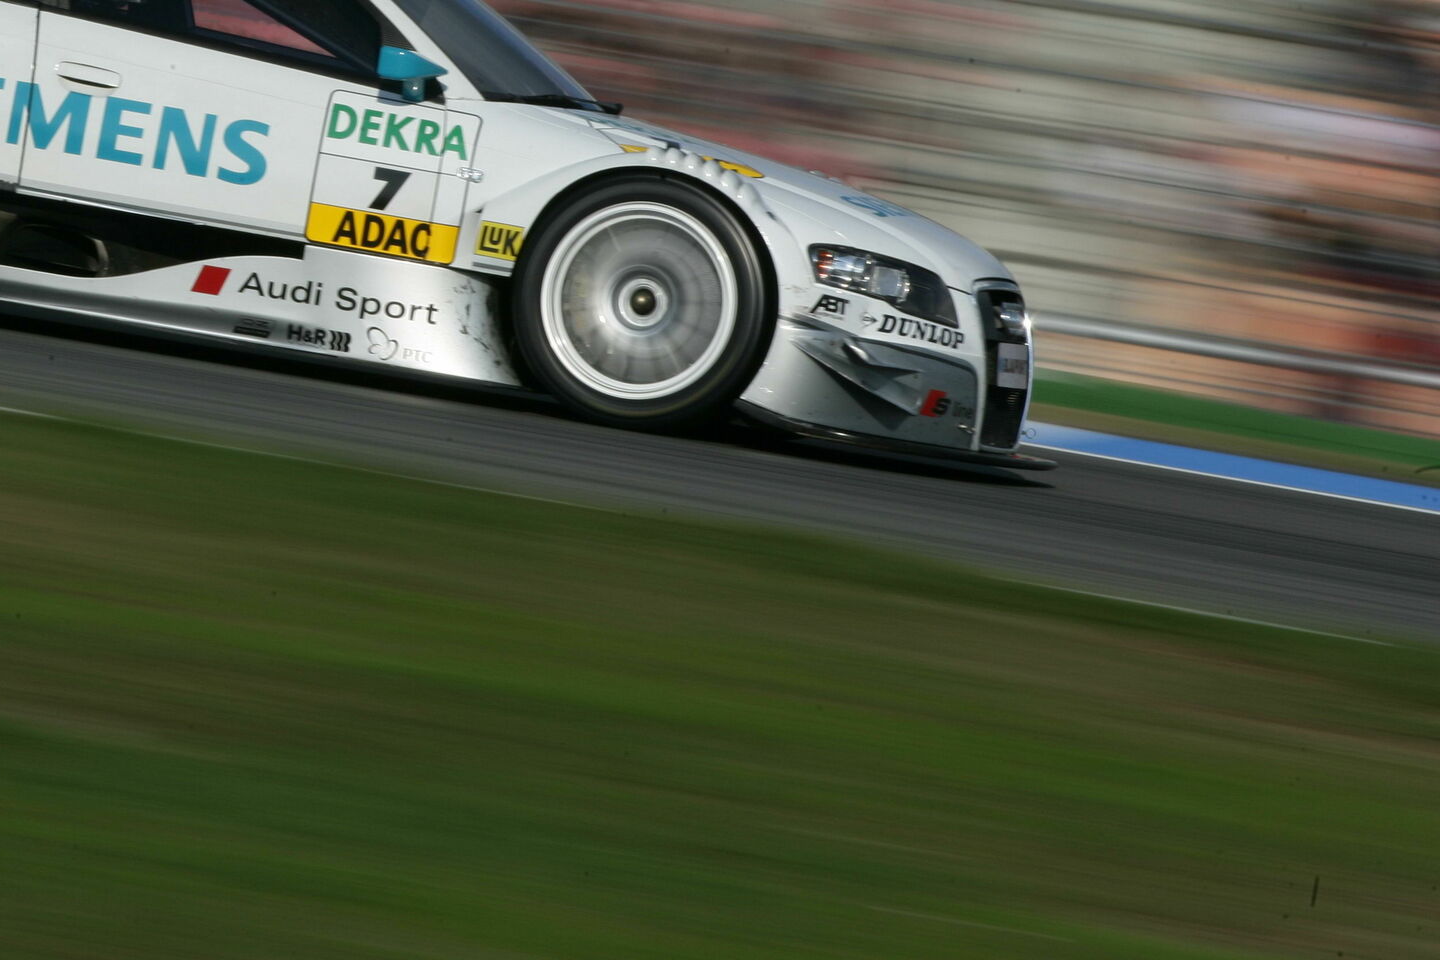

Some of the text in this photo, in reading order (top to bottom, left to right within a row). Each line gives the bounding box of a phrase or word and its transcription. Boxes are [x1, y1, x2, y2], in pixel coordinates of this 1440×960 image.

[327, 103, 468, 161] DEKRA
[369, 166, 413, 211] 7
[332, 210, 433, 260] ADAC
[238, 272, 439, 325] Audi Sport
[810, 294, 850, 315] ABT
[878, 315, 964, 349] DUNLOP
